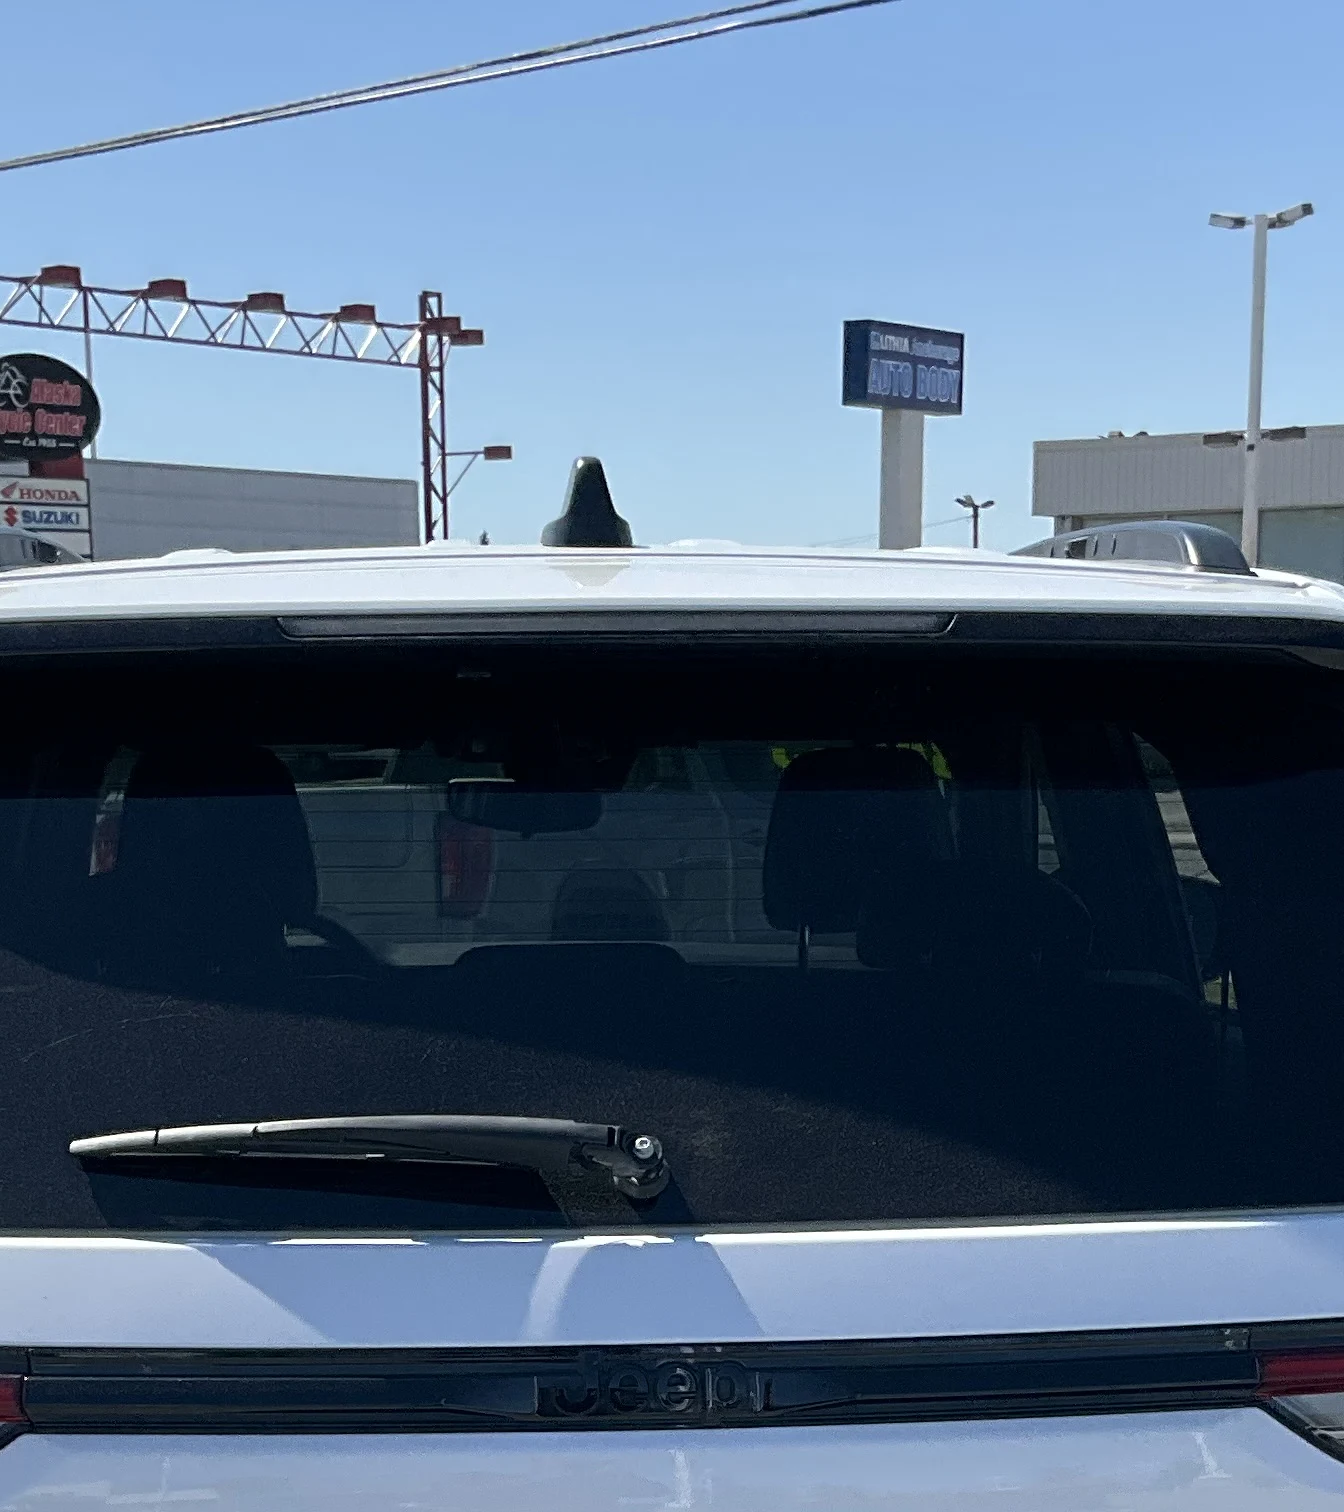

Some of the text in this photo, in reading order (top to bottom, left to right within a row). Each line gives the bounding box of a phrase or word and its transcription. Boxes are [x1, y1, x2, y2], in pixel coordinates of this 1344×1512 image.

[867, 358, 961, 404] AUTO BODY
[19, 488, 82, 502] HONDA
[21, 510, 80, 525] SUZUKI
[553, 1352, 742, 1417] Jeep
